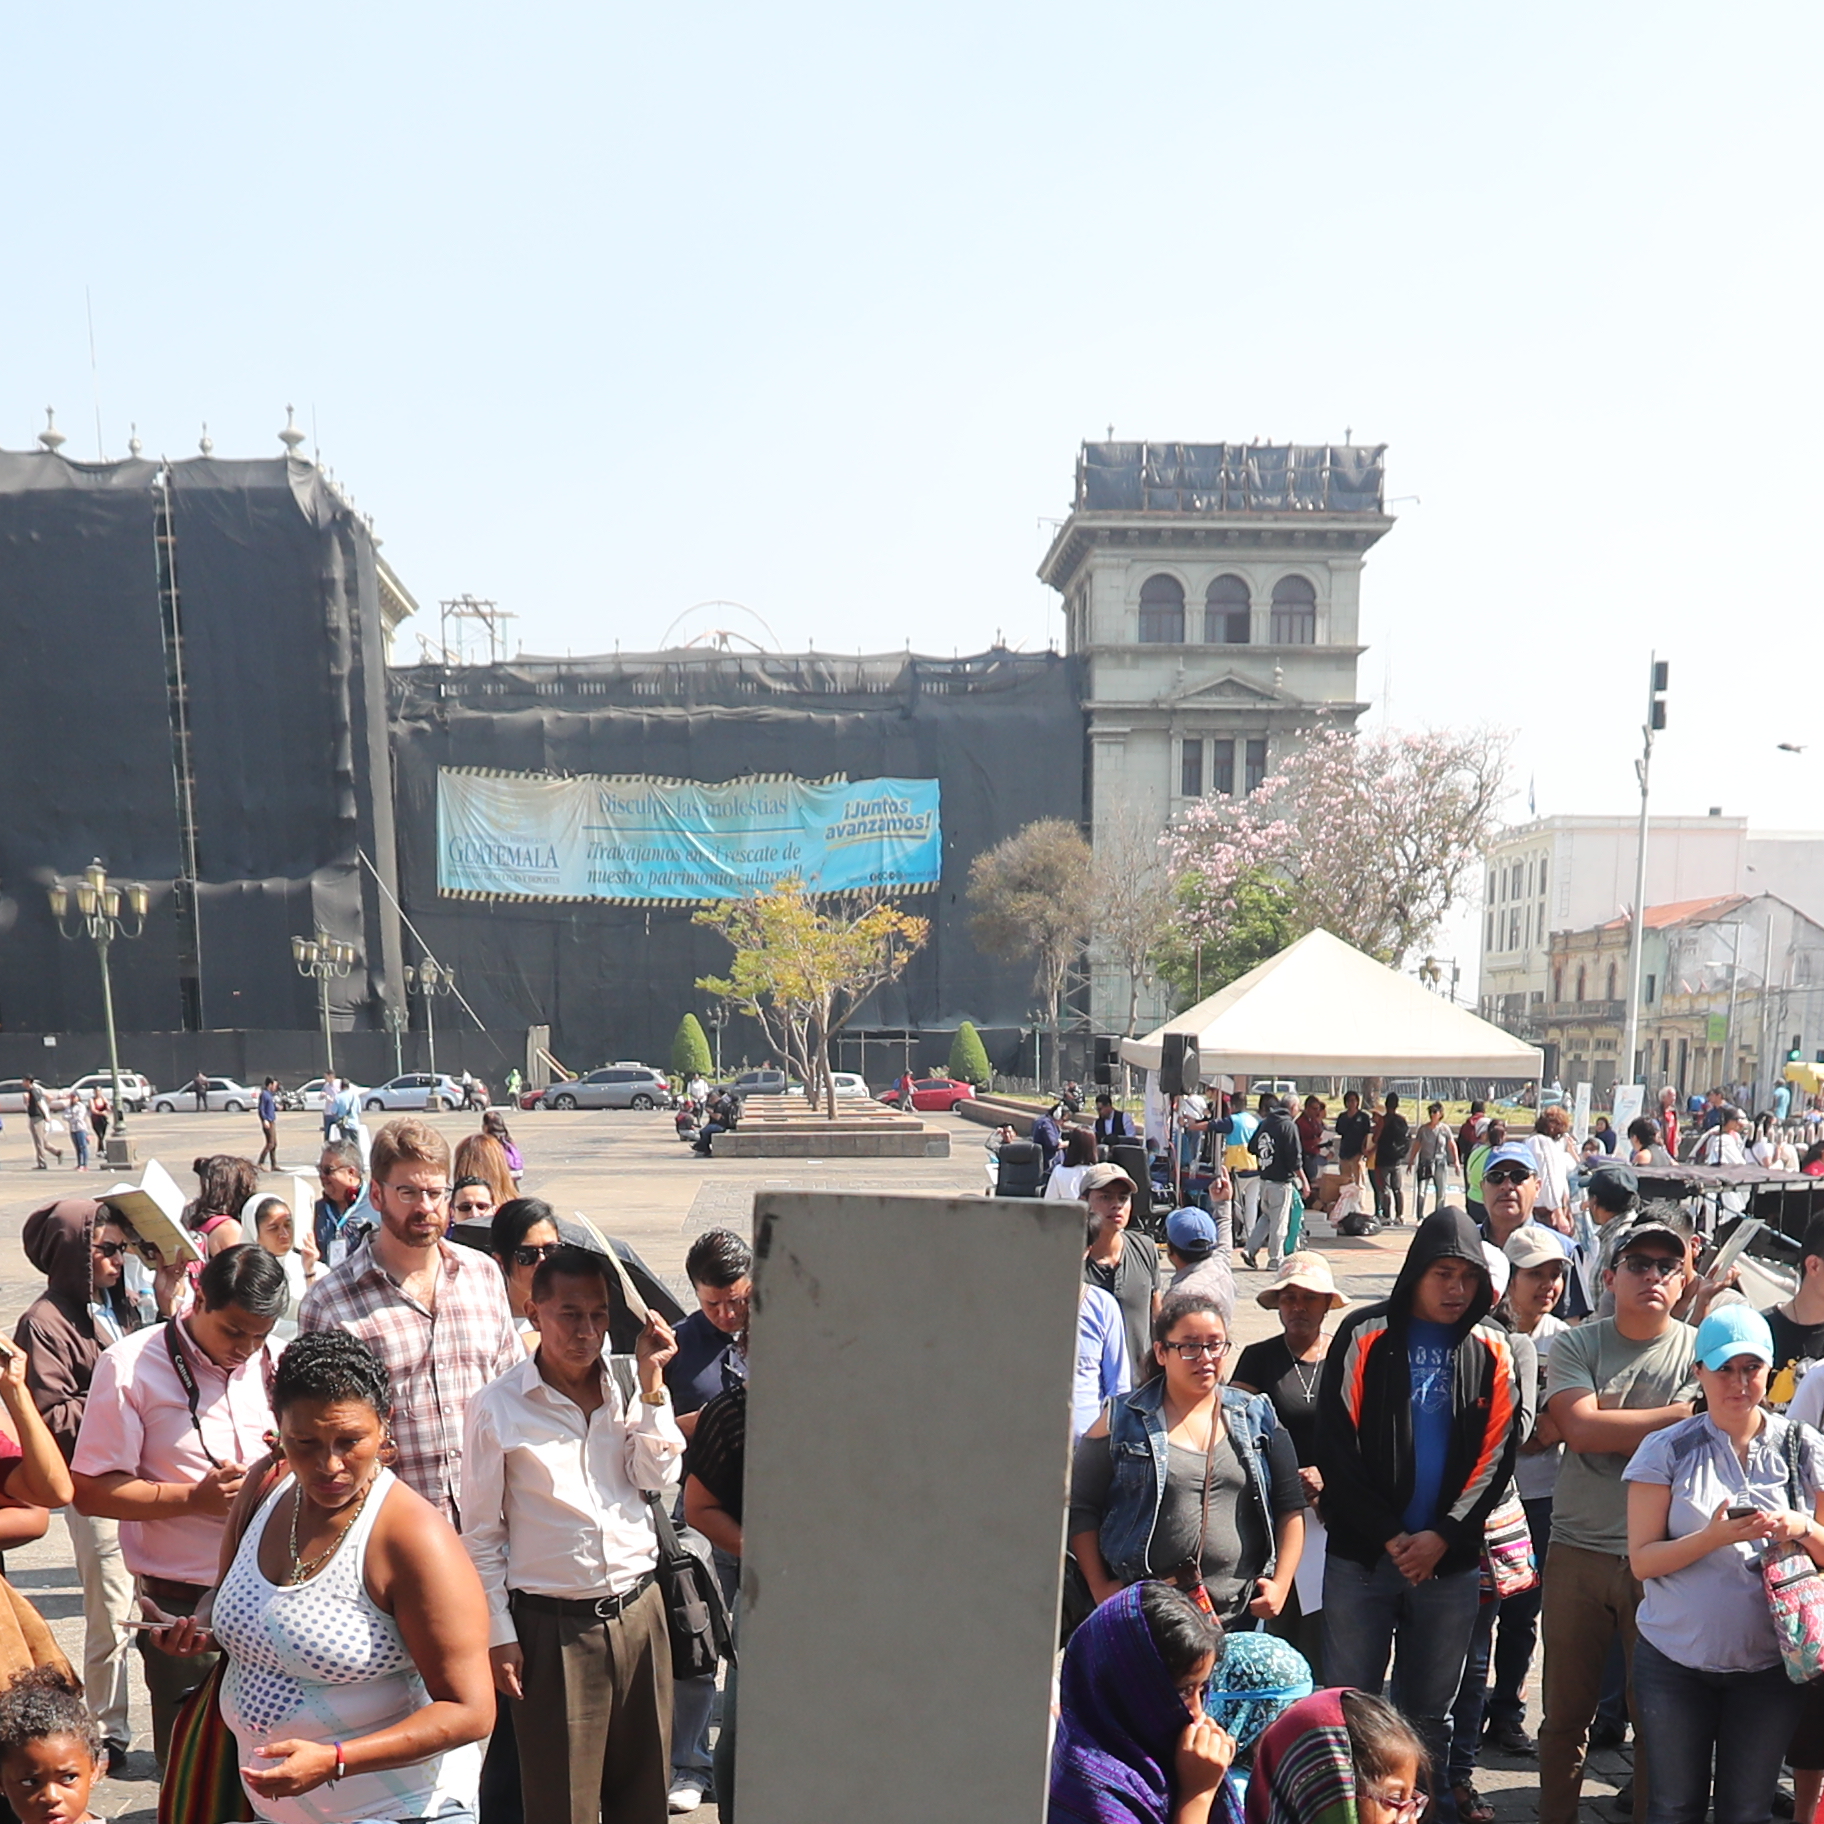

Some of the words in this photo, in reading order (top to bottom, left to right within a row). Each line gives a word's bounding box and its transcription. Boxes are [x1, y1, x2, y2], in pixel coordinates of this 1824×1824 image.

[703, 794, 787, 819] molestias
[844, 799, 910, 820] ¡Juntos
[825, 813, 932, 840] avanzamos!
[448, 837, 559, 870] GUATEMALA
[782, 842, 801, 861] de
[586, 869, 644, 885] nuestro
[648, 869, 734, 889] patrimonio
[174, 1354, 193, 1389] Canon
